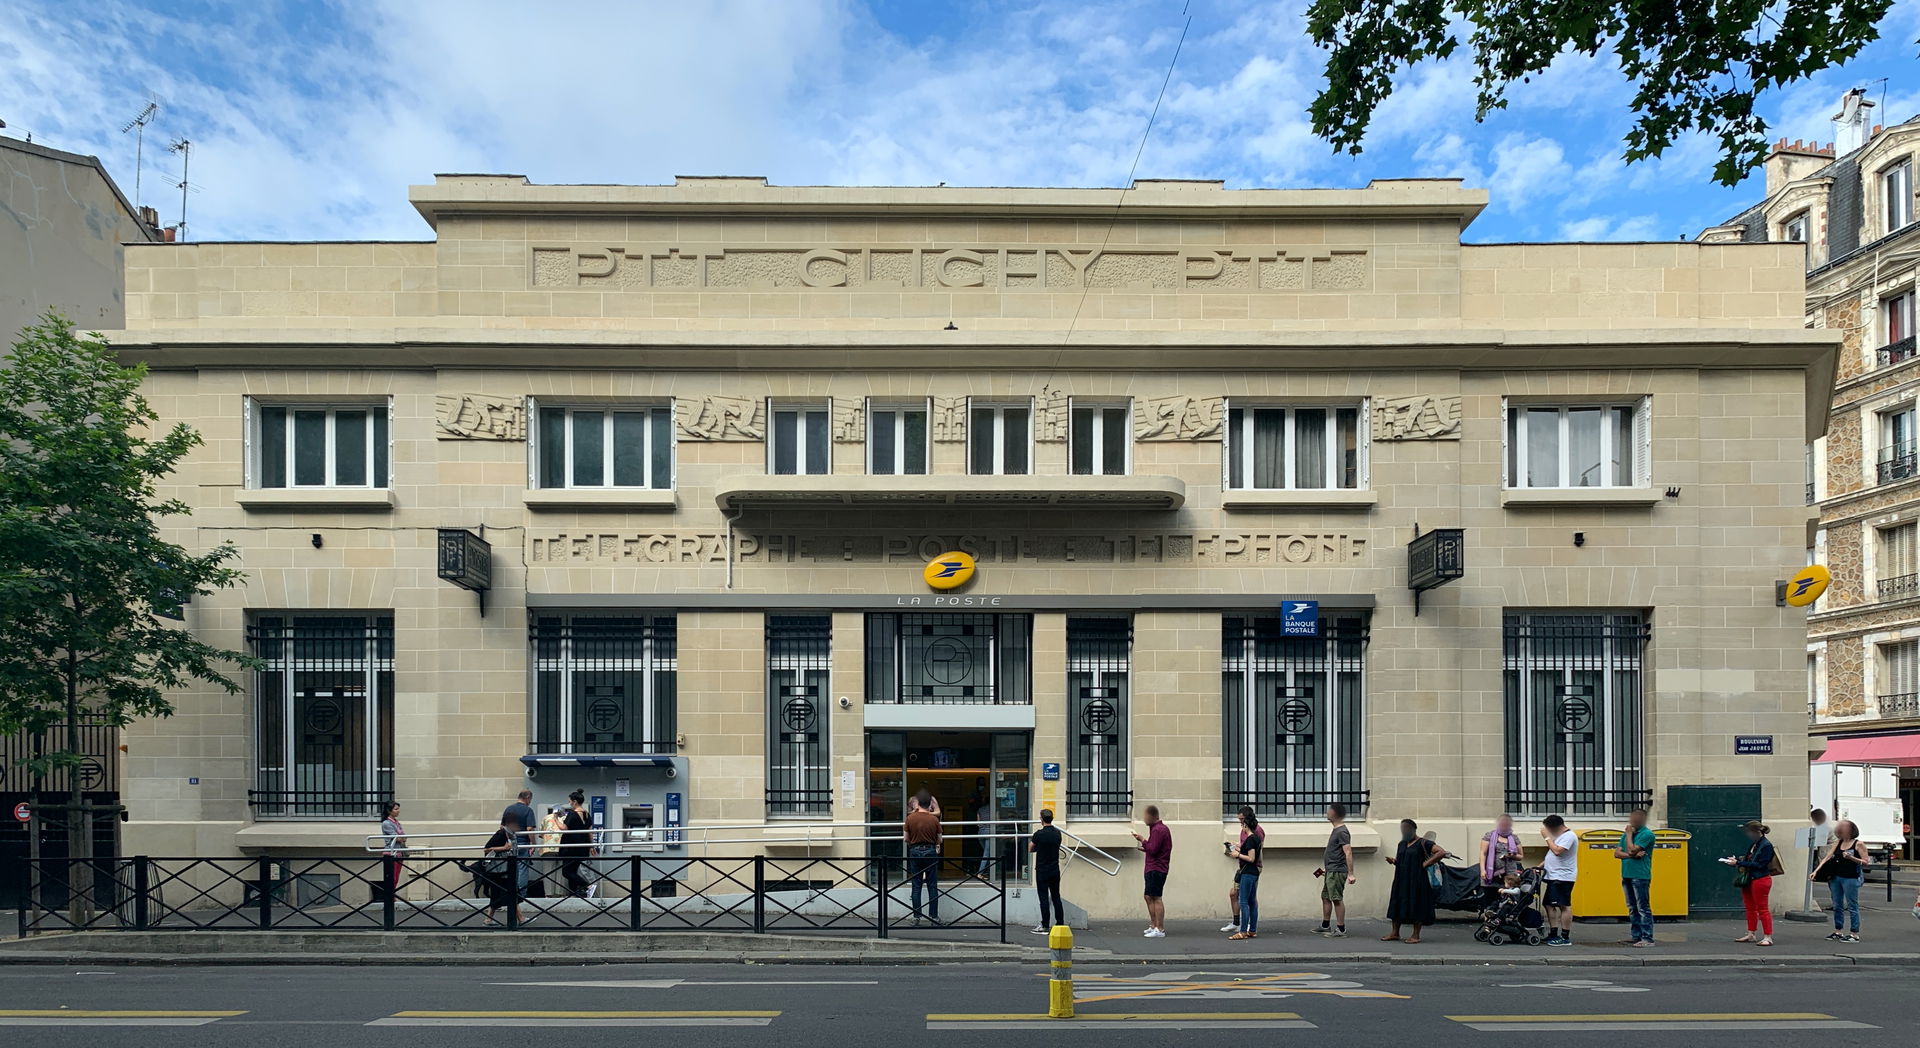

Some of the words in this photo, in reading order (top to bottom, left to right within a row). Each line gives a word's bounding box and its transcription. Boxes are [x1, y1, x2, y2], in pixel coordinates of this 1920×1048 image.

[570, 248, 725, 288] PTT
[800, 248, 1102, 288] CLICHY
[1177, 249, 1332, 289] PTT
[533, 534, 816, 562] TELEGRAPHE
[883, 535, 1038, 562] POSTE
[1100, 535, 1367, 563] TELEPHONE
[897, 597, 921, 605] LA
[935, 597, 1001, 605] POSTE
